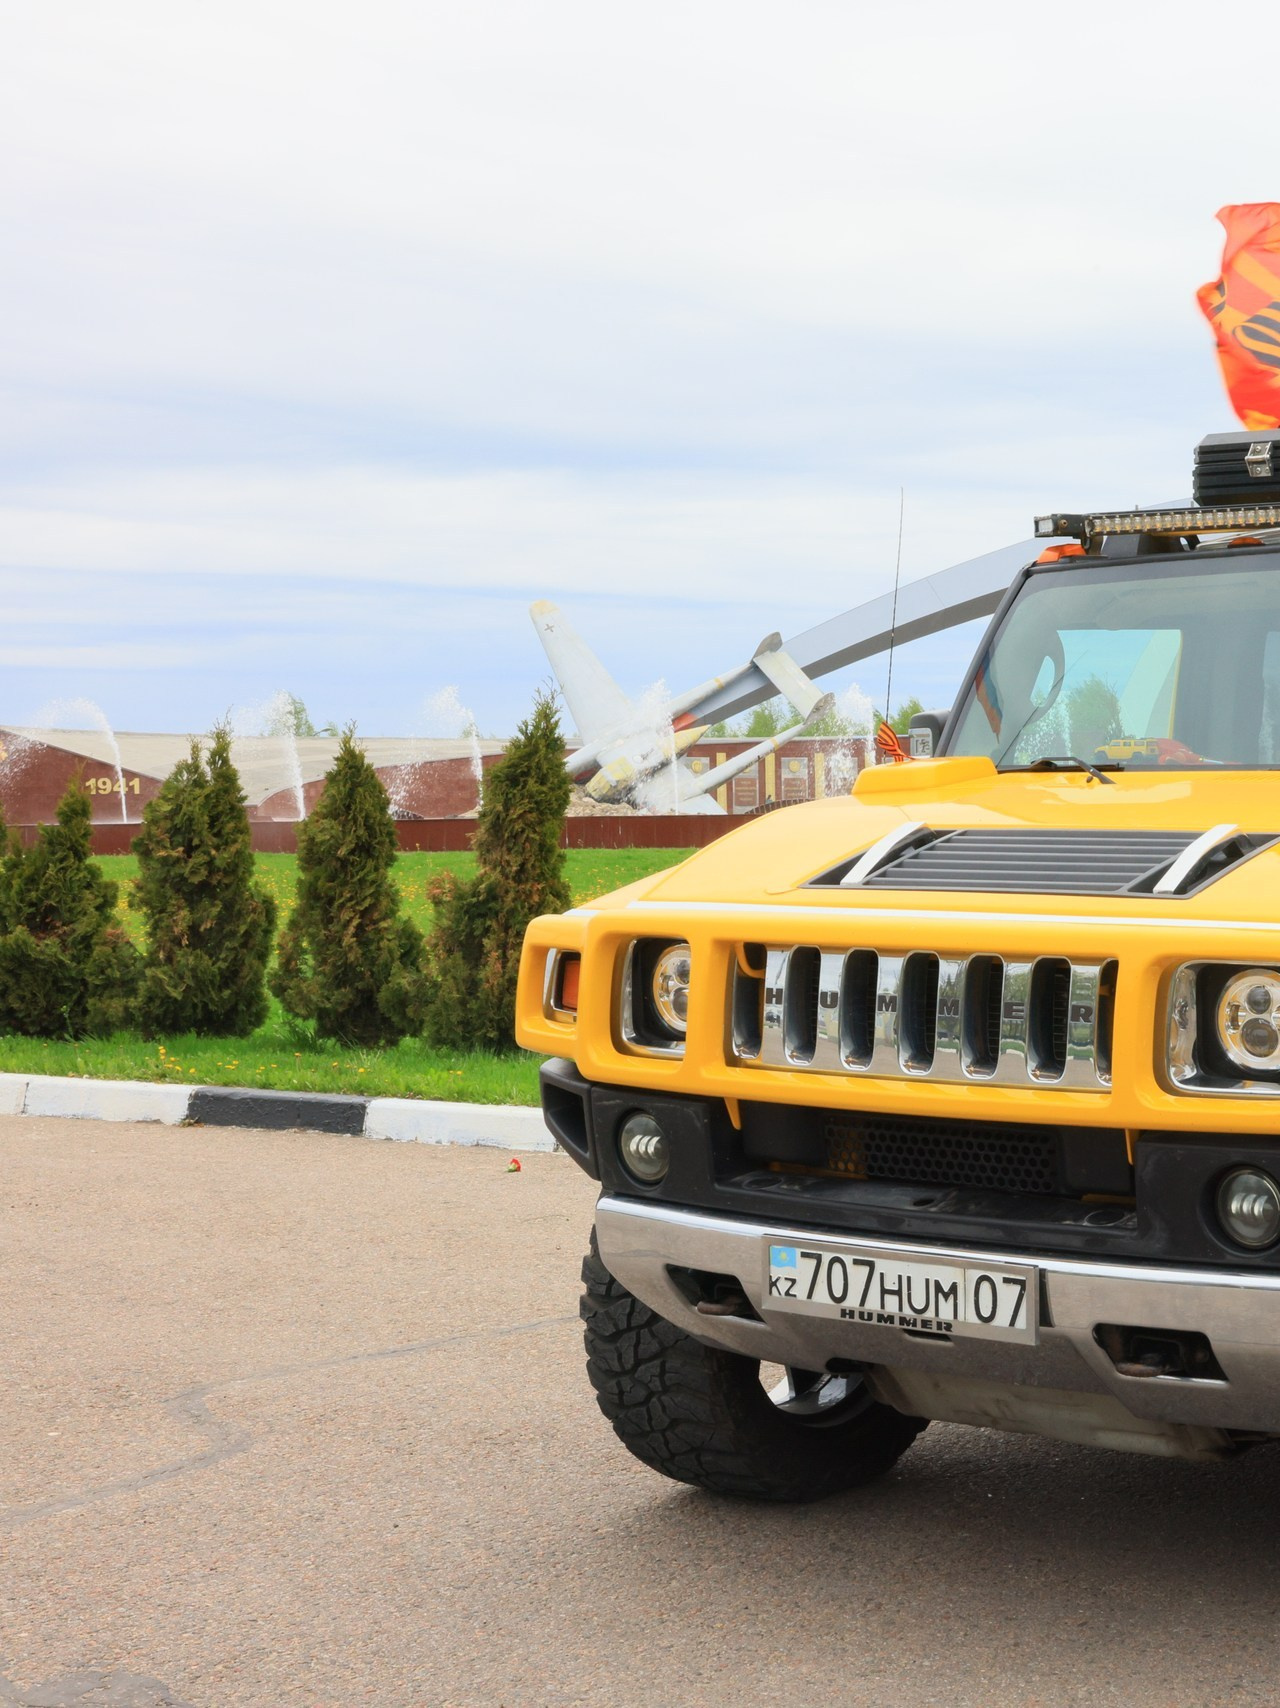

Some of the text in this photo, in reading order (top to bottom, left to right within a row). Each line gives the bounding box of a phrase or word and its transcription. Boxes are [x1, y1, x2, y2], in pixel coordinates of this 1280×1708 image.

[85, 777, 140, 795] 1941
[765, 987, 1094, 1024] HUMMER
[769, 1274, 797, 1298] KZ
[973, 1273, 1027, 1328] 07
[840, 1307, 954, 1333] HUMMER
